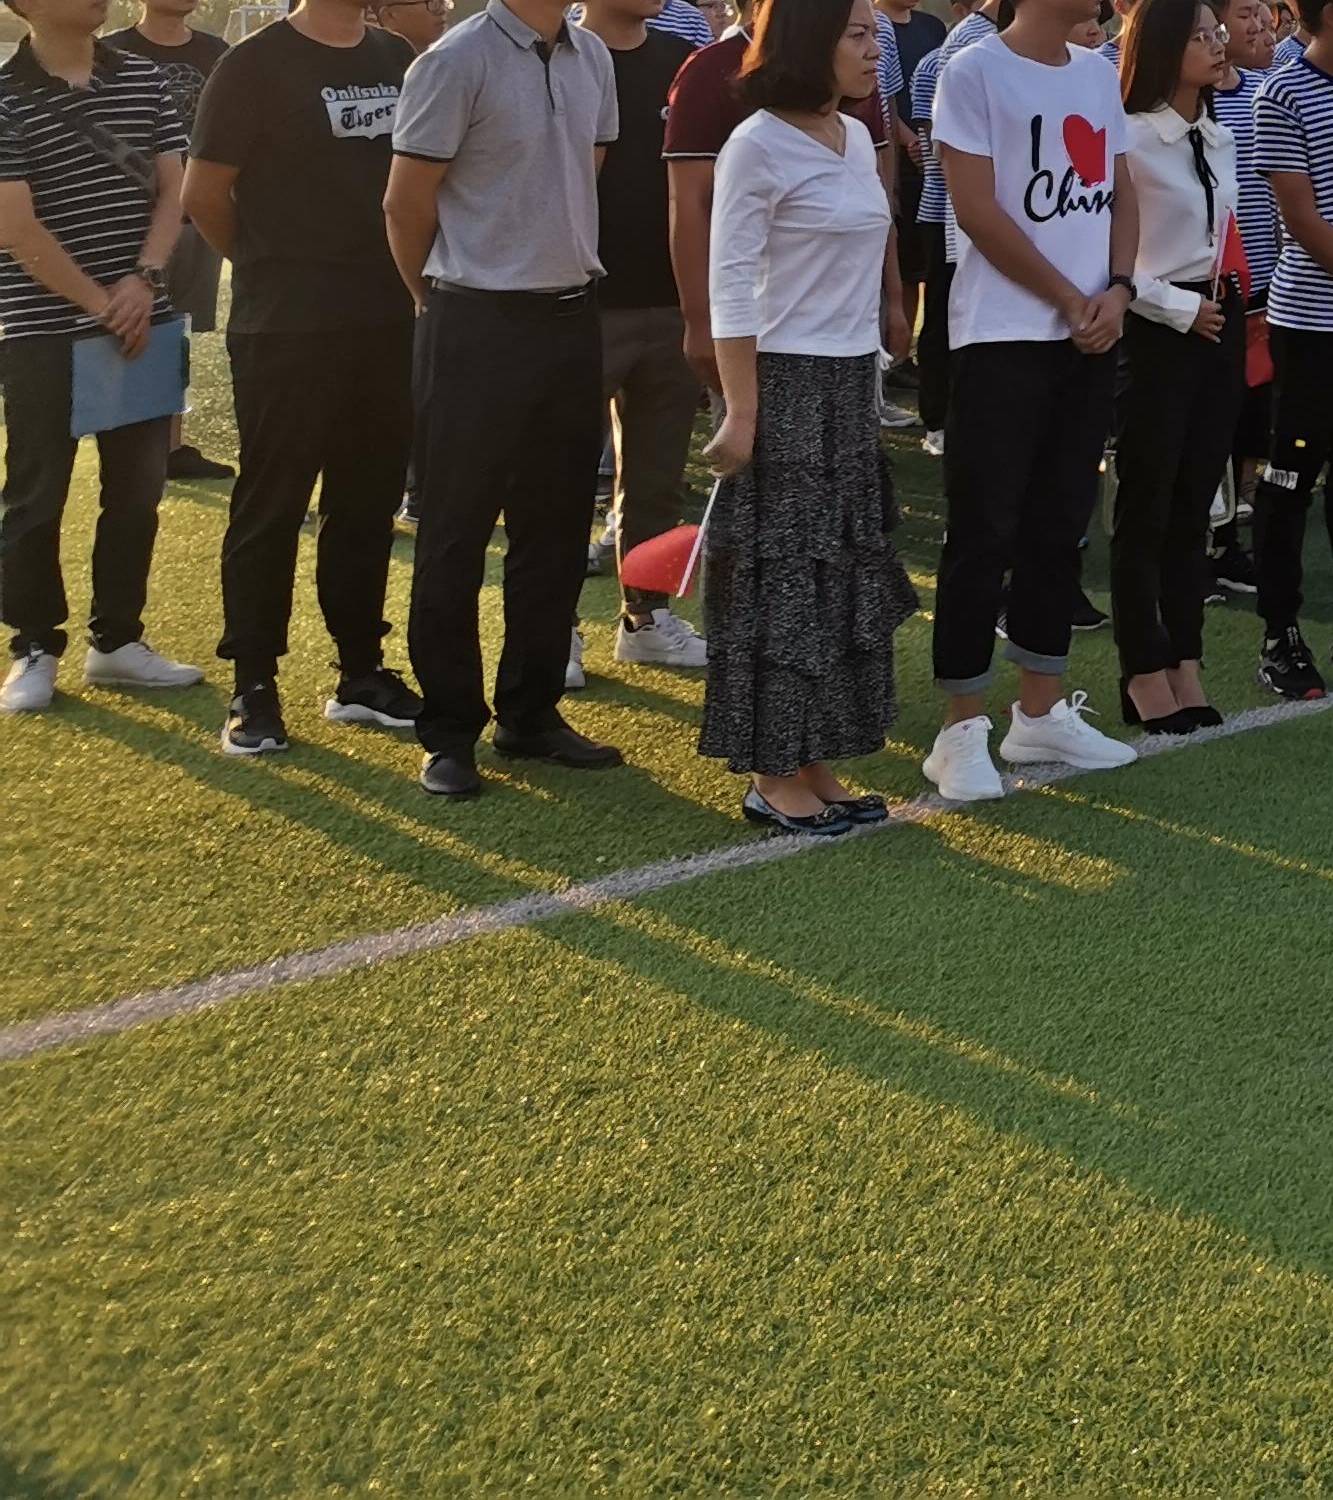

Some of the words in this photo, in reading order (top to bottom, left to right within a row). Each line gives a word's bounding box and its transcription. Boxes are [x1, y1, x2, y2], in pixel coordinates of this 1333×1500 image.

[341, 104, 396, 130] Tiger
[1030, 114, 1042, 172] I
[1023, 165, 1116, 222] Chin
